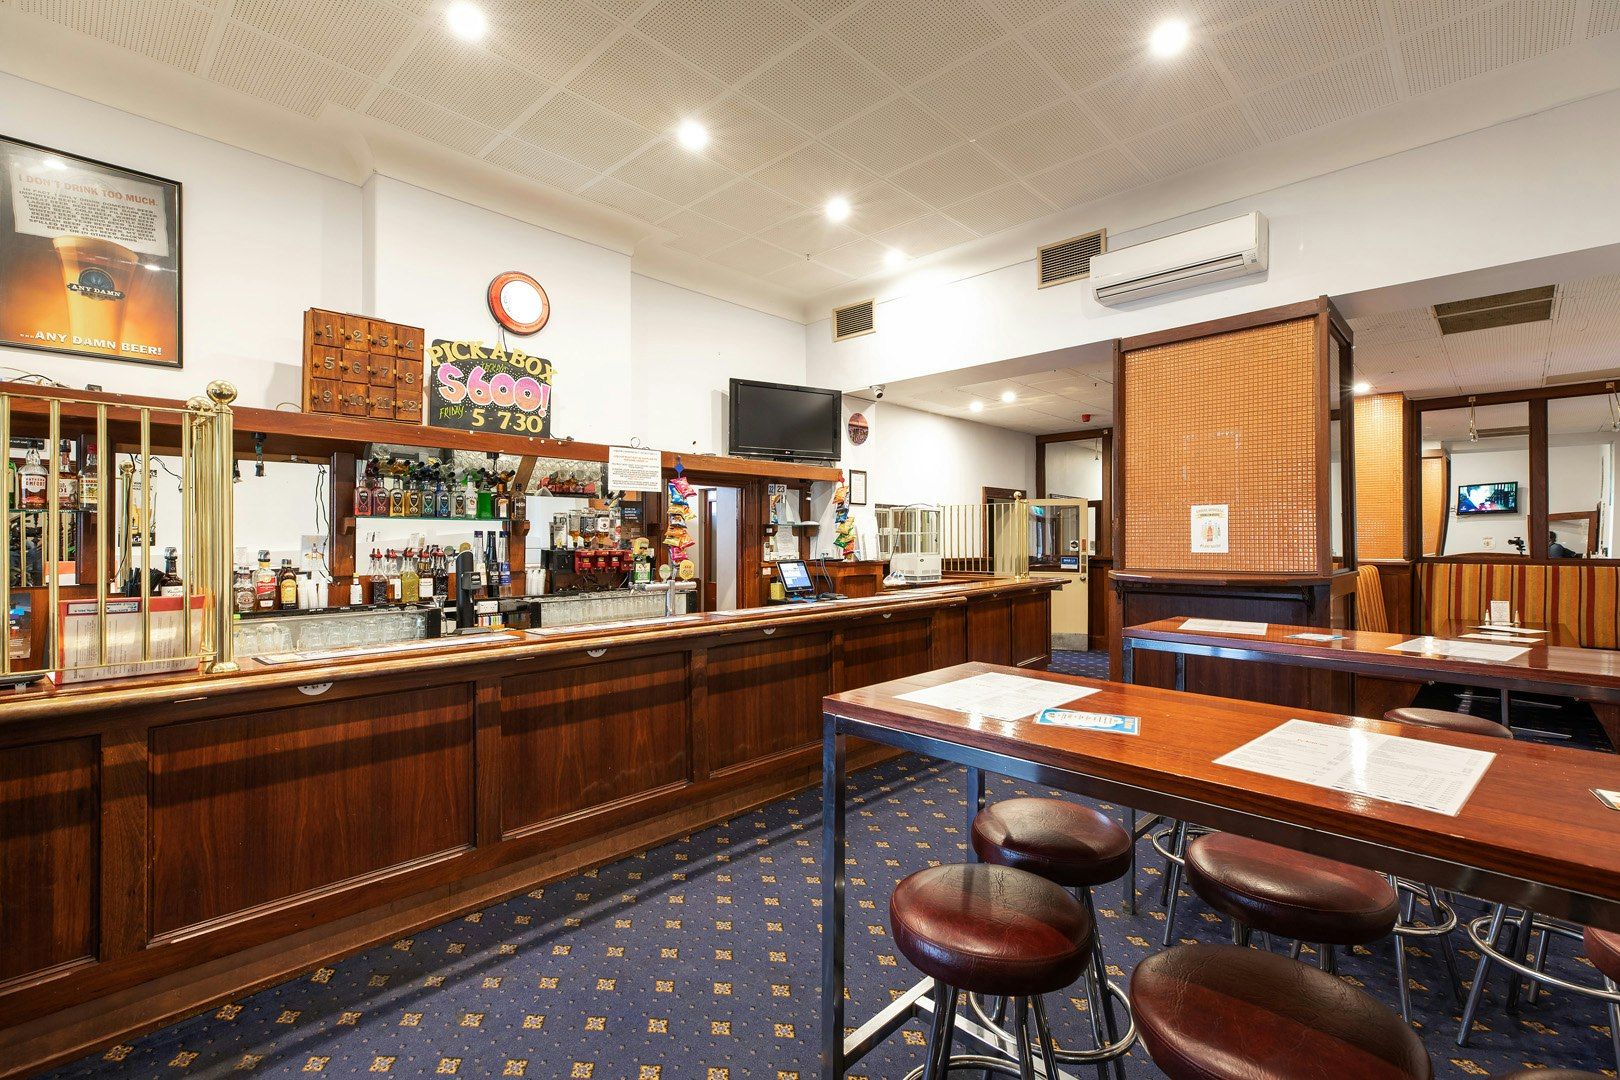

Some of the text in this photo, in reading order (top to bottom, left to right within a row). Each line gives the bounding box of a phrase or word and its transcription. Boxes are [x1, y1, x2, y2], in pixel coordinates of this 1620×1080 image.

[64, 182, 98, 196] DRINK
[101, 190, 122, 200] TOO
[126, 194, 158, 206] MUCH.
[94, 288, 121, 297] DAMN
[326, 325, 332, 338] 1
[353, 330, 362, 342] 2
[72, 335, 116, 350] DAMN
[121, 342, 162, 356] BEER!
[379, 335, 388, 347] 3
[406, 340, 415, 352] 4
[324, 356, 335, 369] 5
[353, 361, 360, 374] 6
[426, 341, 558, 386] PICK A BOX
[380, 367, 388, 378] 7
[405, 372, 414, 384] 8
[323, 390, 332, 403] 9
[437, 362, 551, 418] $600!
[349, 393, 364, 406] 10
[377, 396, 390, 409] 11
[401, 400, 418, 411] 12
[440, 406, 464, 420] FRIDAY
